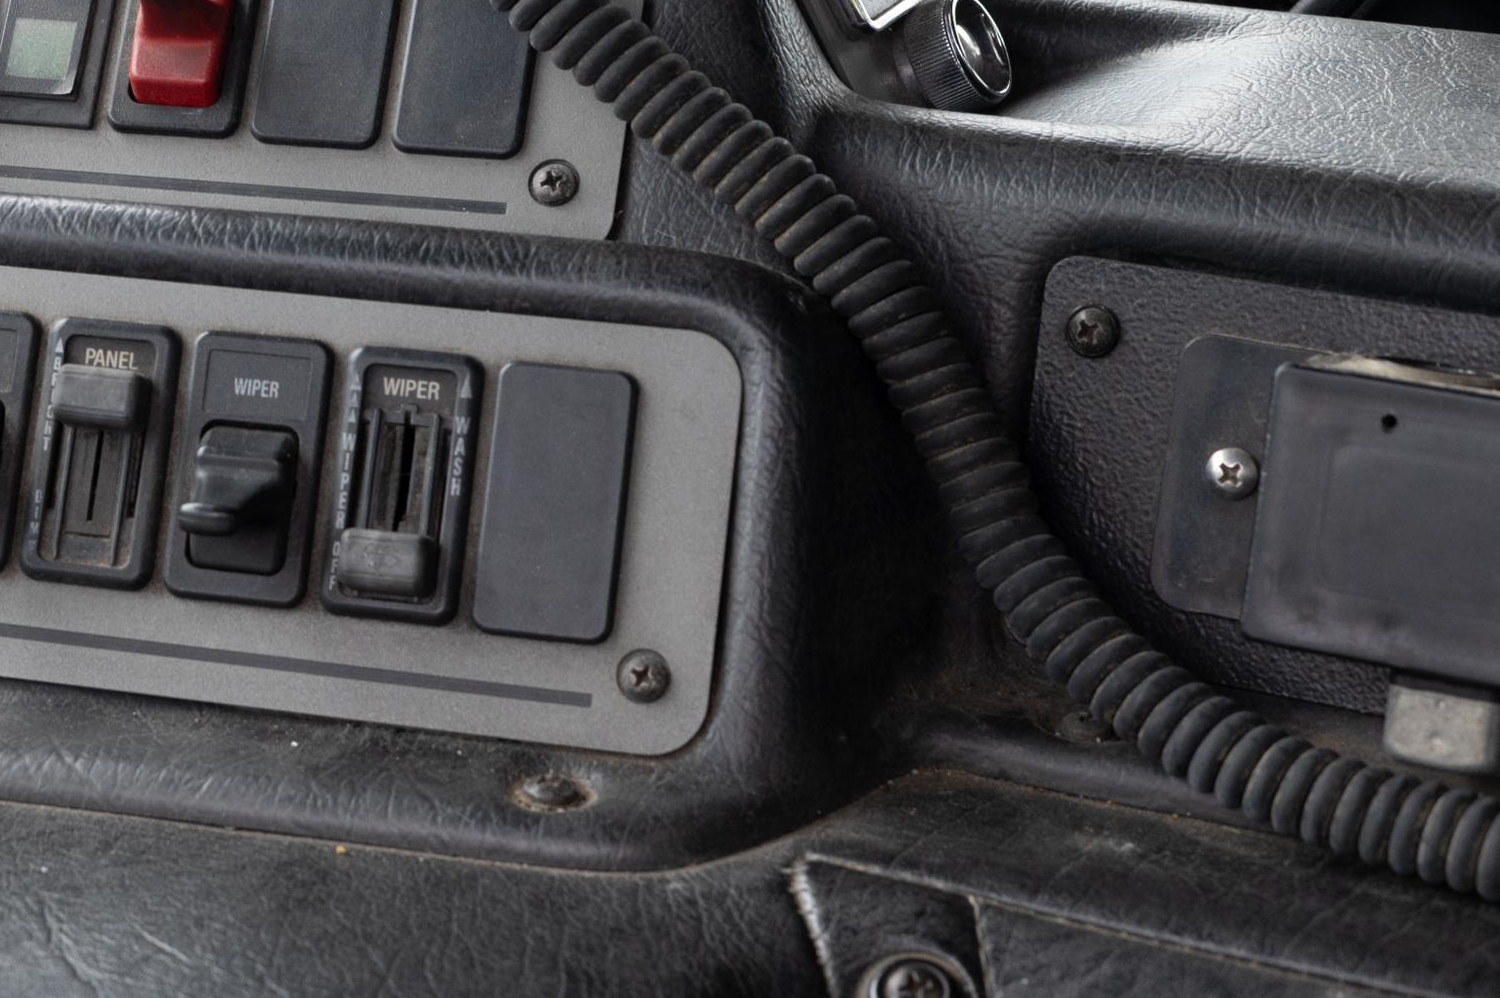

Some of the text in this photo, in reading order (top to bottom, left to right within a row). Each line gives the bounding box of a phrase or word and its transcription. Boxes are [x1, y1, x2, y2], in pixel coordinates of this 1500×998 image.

[84, 348, 139, 371] PANEL
[234, 377, 280, 399] WIPER
[383, 377, 441, 401] WIPER
[450, 416, 472, 496] WASH
[334, 432, 356, 529] WIPER
